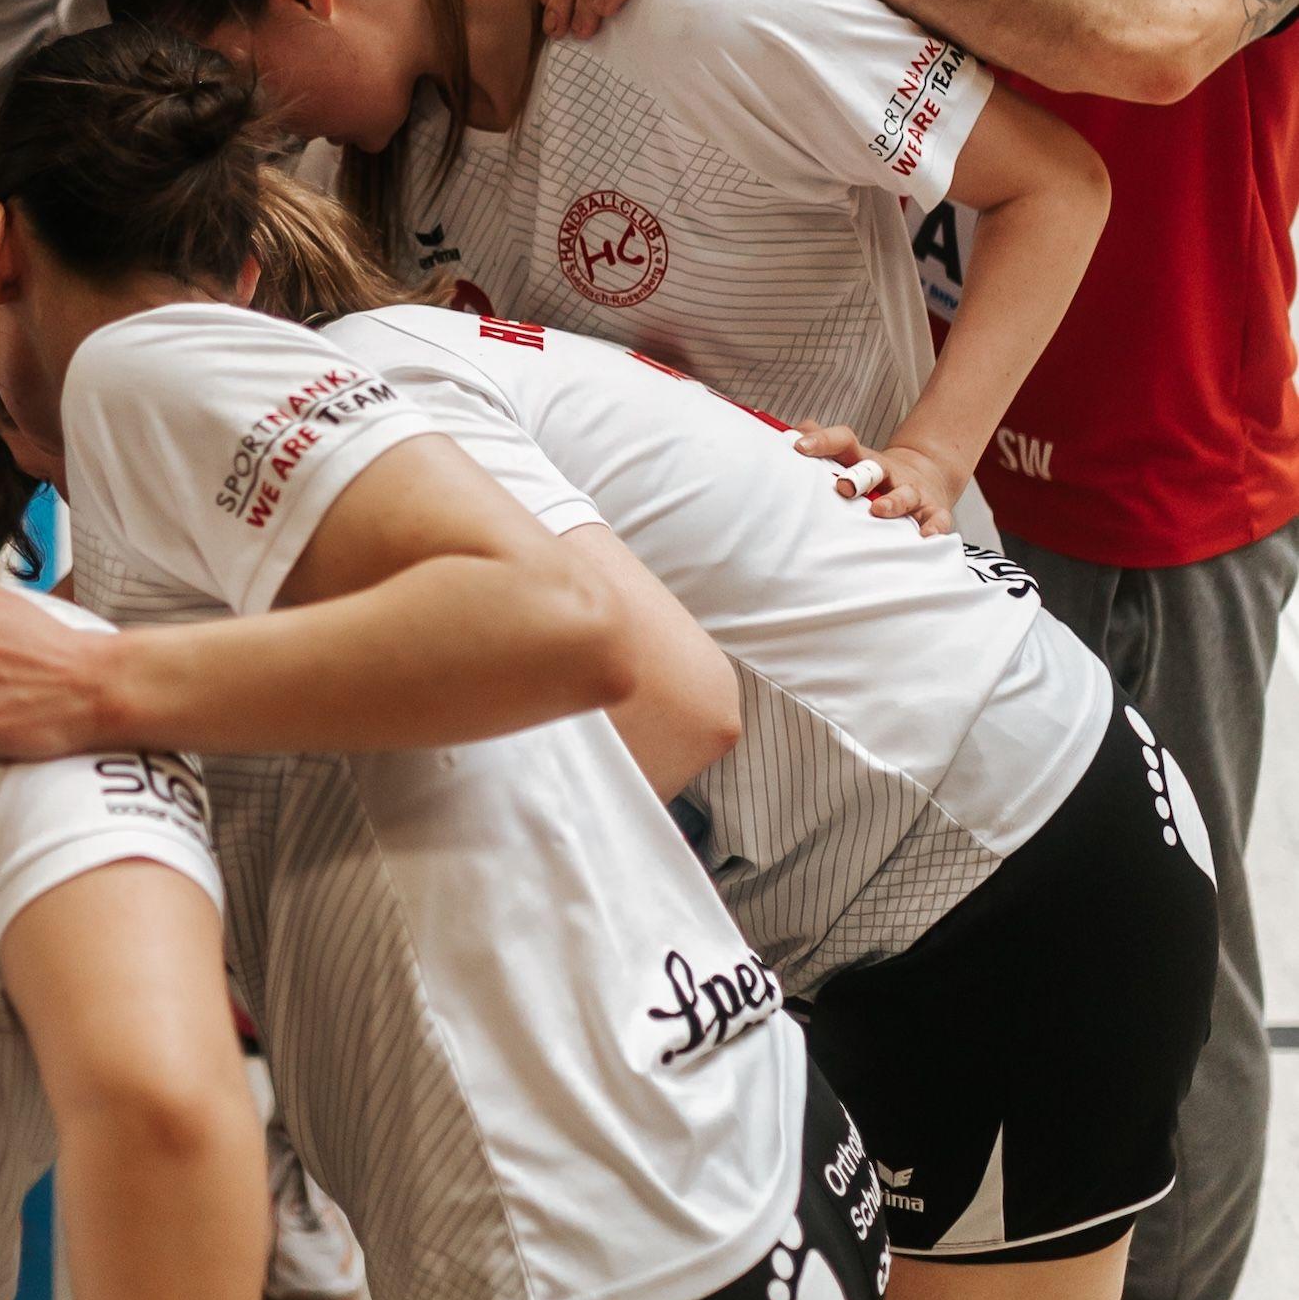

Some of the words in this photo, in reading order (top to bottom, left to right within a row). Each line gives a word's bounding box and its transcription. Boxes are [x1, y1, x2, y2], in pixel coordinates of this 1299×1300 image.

[868, 37, 945, 157] SPORTNANK
[891, 140, 922, 177] WE
[907, 98, 941, 145] ARE
[559, 194, 662, 263] HANDBALLCLUB
[579, 223, 645, 284] HC
[215, 369, 359, 513] SPORTNANK
[246, 481, 281, 528] WE
[271, 426, 322, 482] ARE
[315, 383, 398, 425] TEAM
[996, 425, 1053, 481] SW
[879, 1187, 925, 1213] rima
